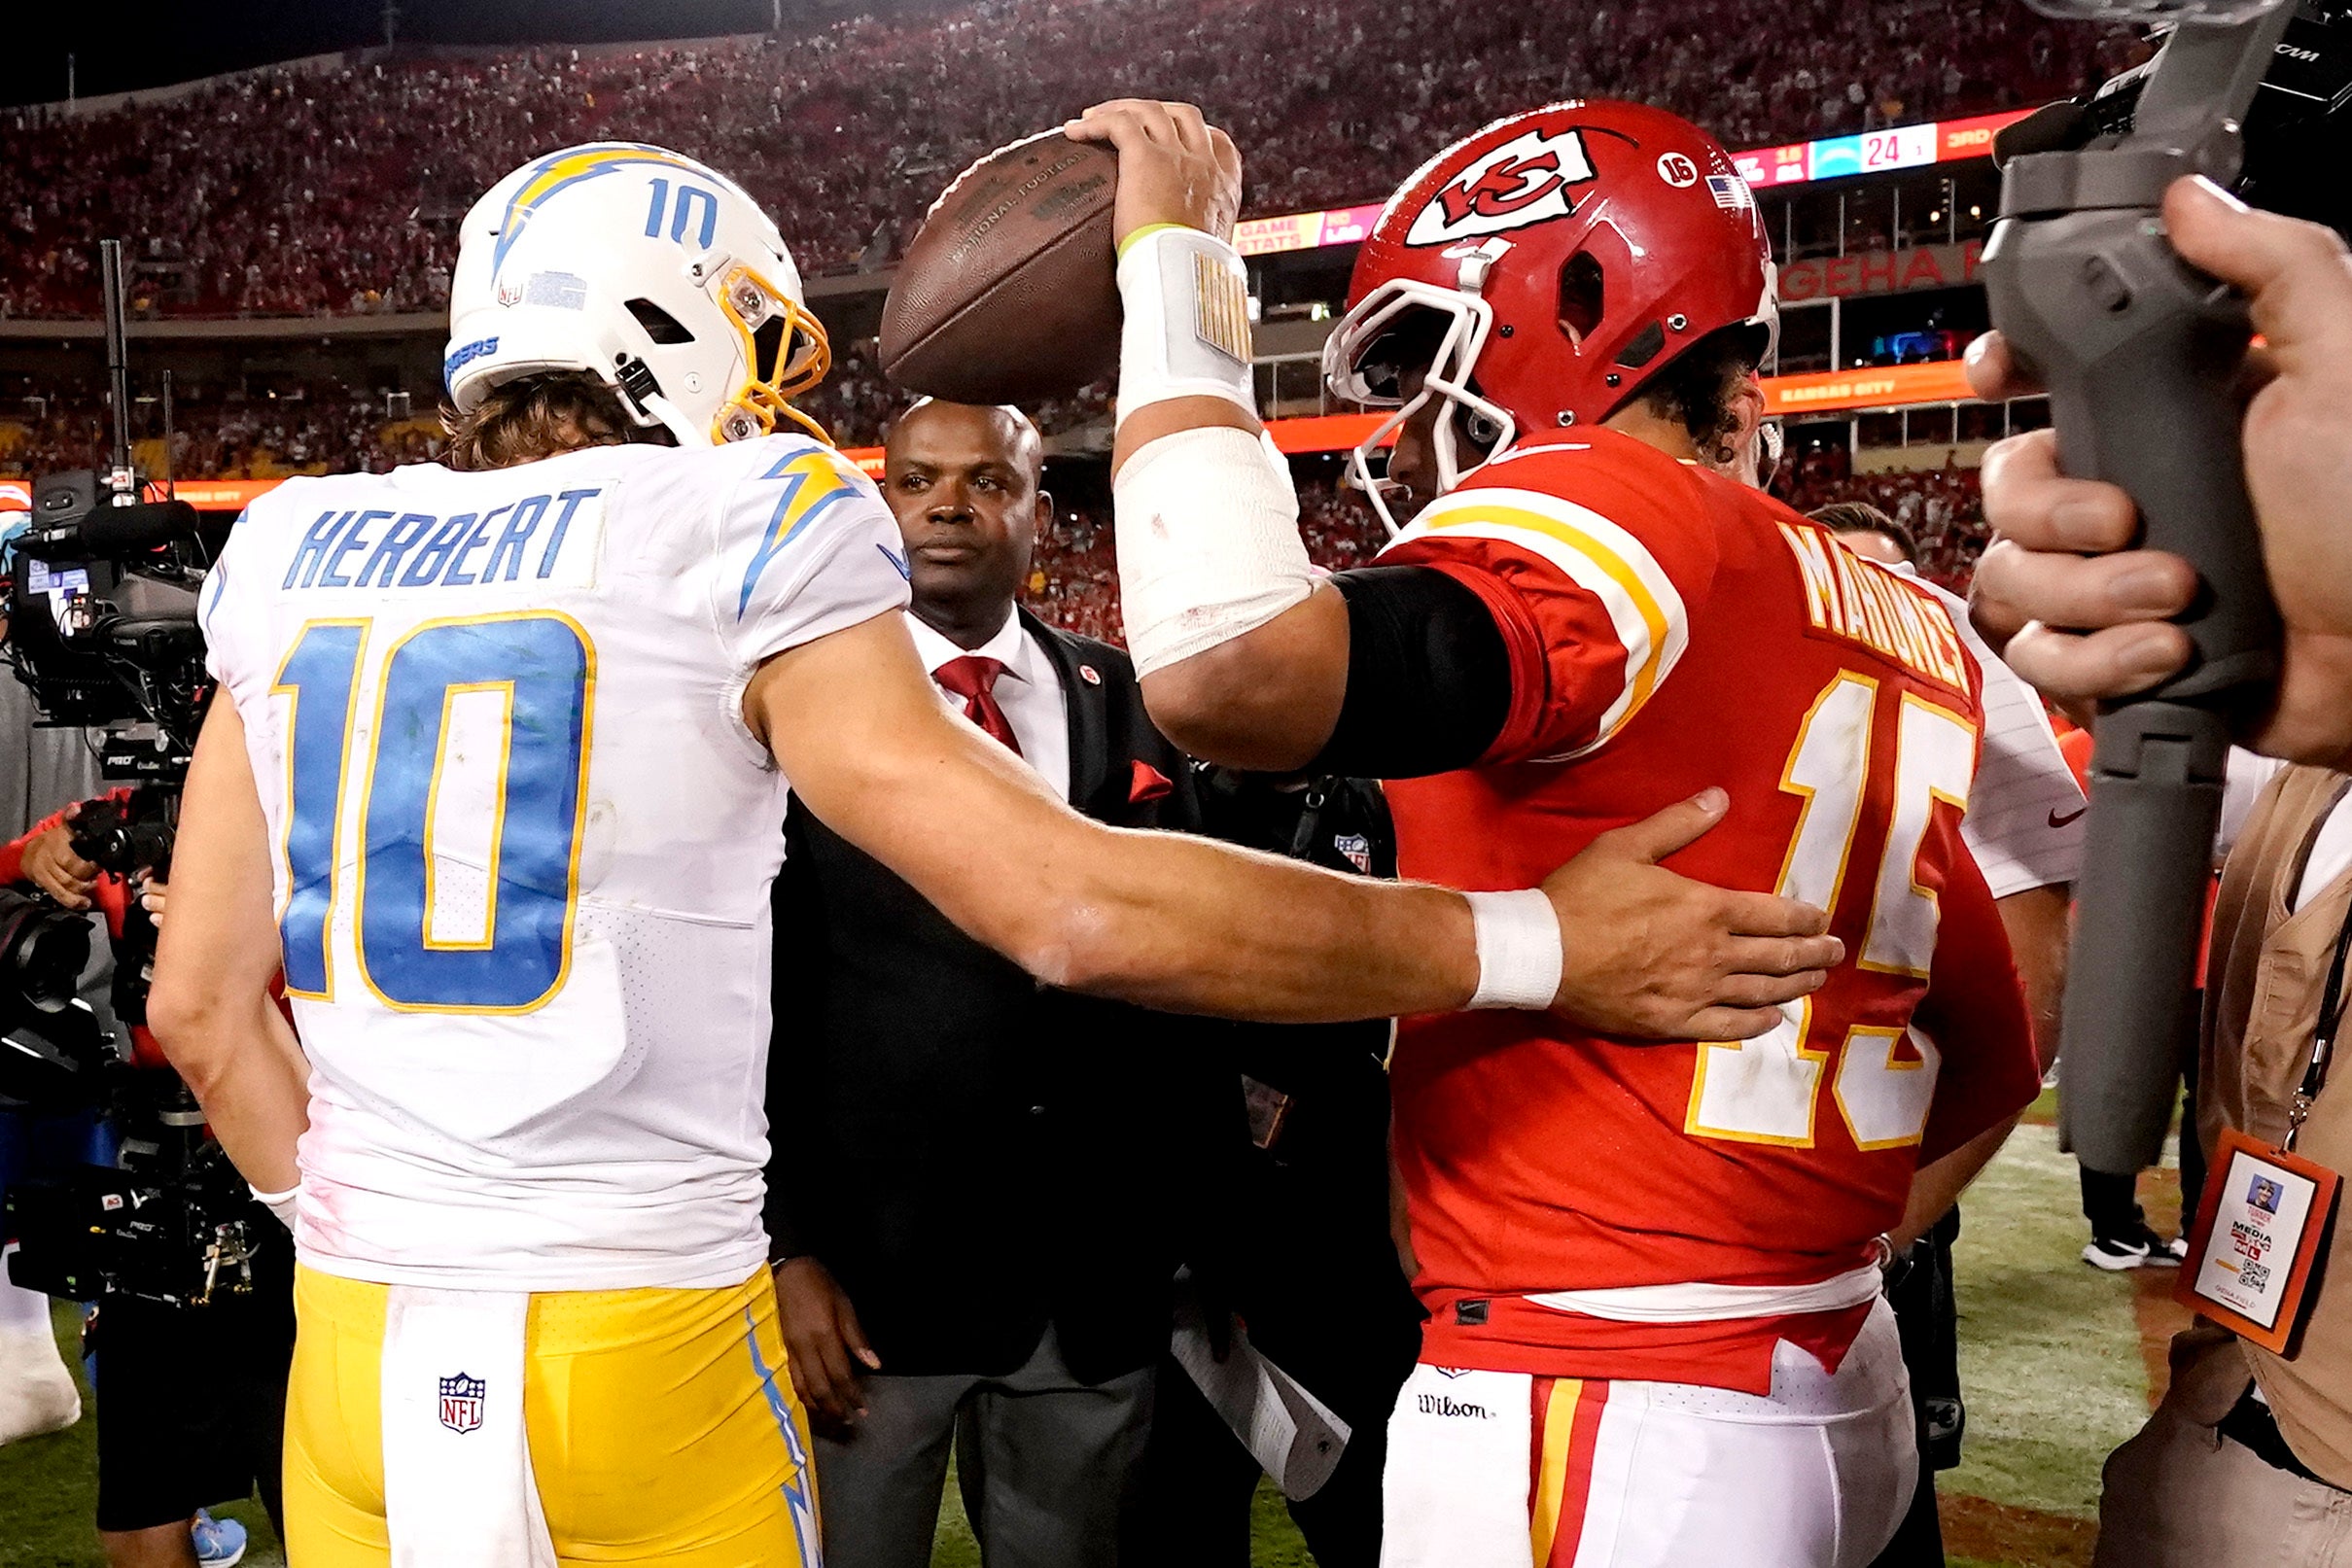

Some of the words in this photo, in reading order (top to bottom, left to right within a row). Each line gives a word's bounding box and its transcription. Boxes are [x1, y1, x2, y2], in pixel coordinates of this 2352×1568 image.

[1868, 135, 1900, 166] 24
[1662, 157, 1694, 183] 16
[646, 178, 718, 250] 10
[1240, 218, 1299, 238] GAME
[1237, 233, 1301, 254] STATS
[1778, 248, 1944, 300] GEHA
[500, 287, 520, 303] NFL
[1853, 380, 1895, 396] CITY
[282, 488, 602, 590] HERBERT
[1774, 520, 1972, 698] MAHOMES
[268, 609, 598, 1017] 10
[1685, 667, 1979, 1152] 15
[2232, 1220, 2272, 1244] MEDIA
[442, 1398, 480, 1428] NFL
[1418, 1394, 1488, 1420] Wilson
